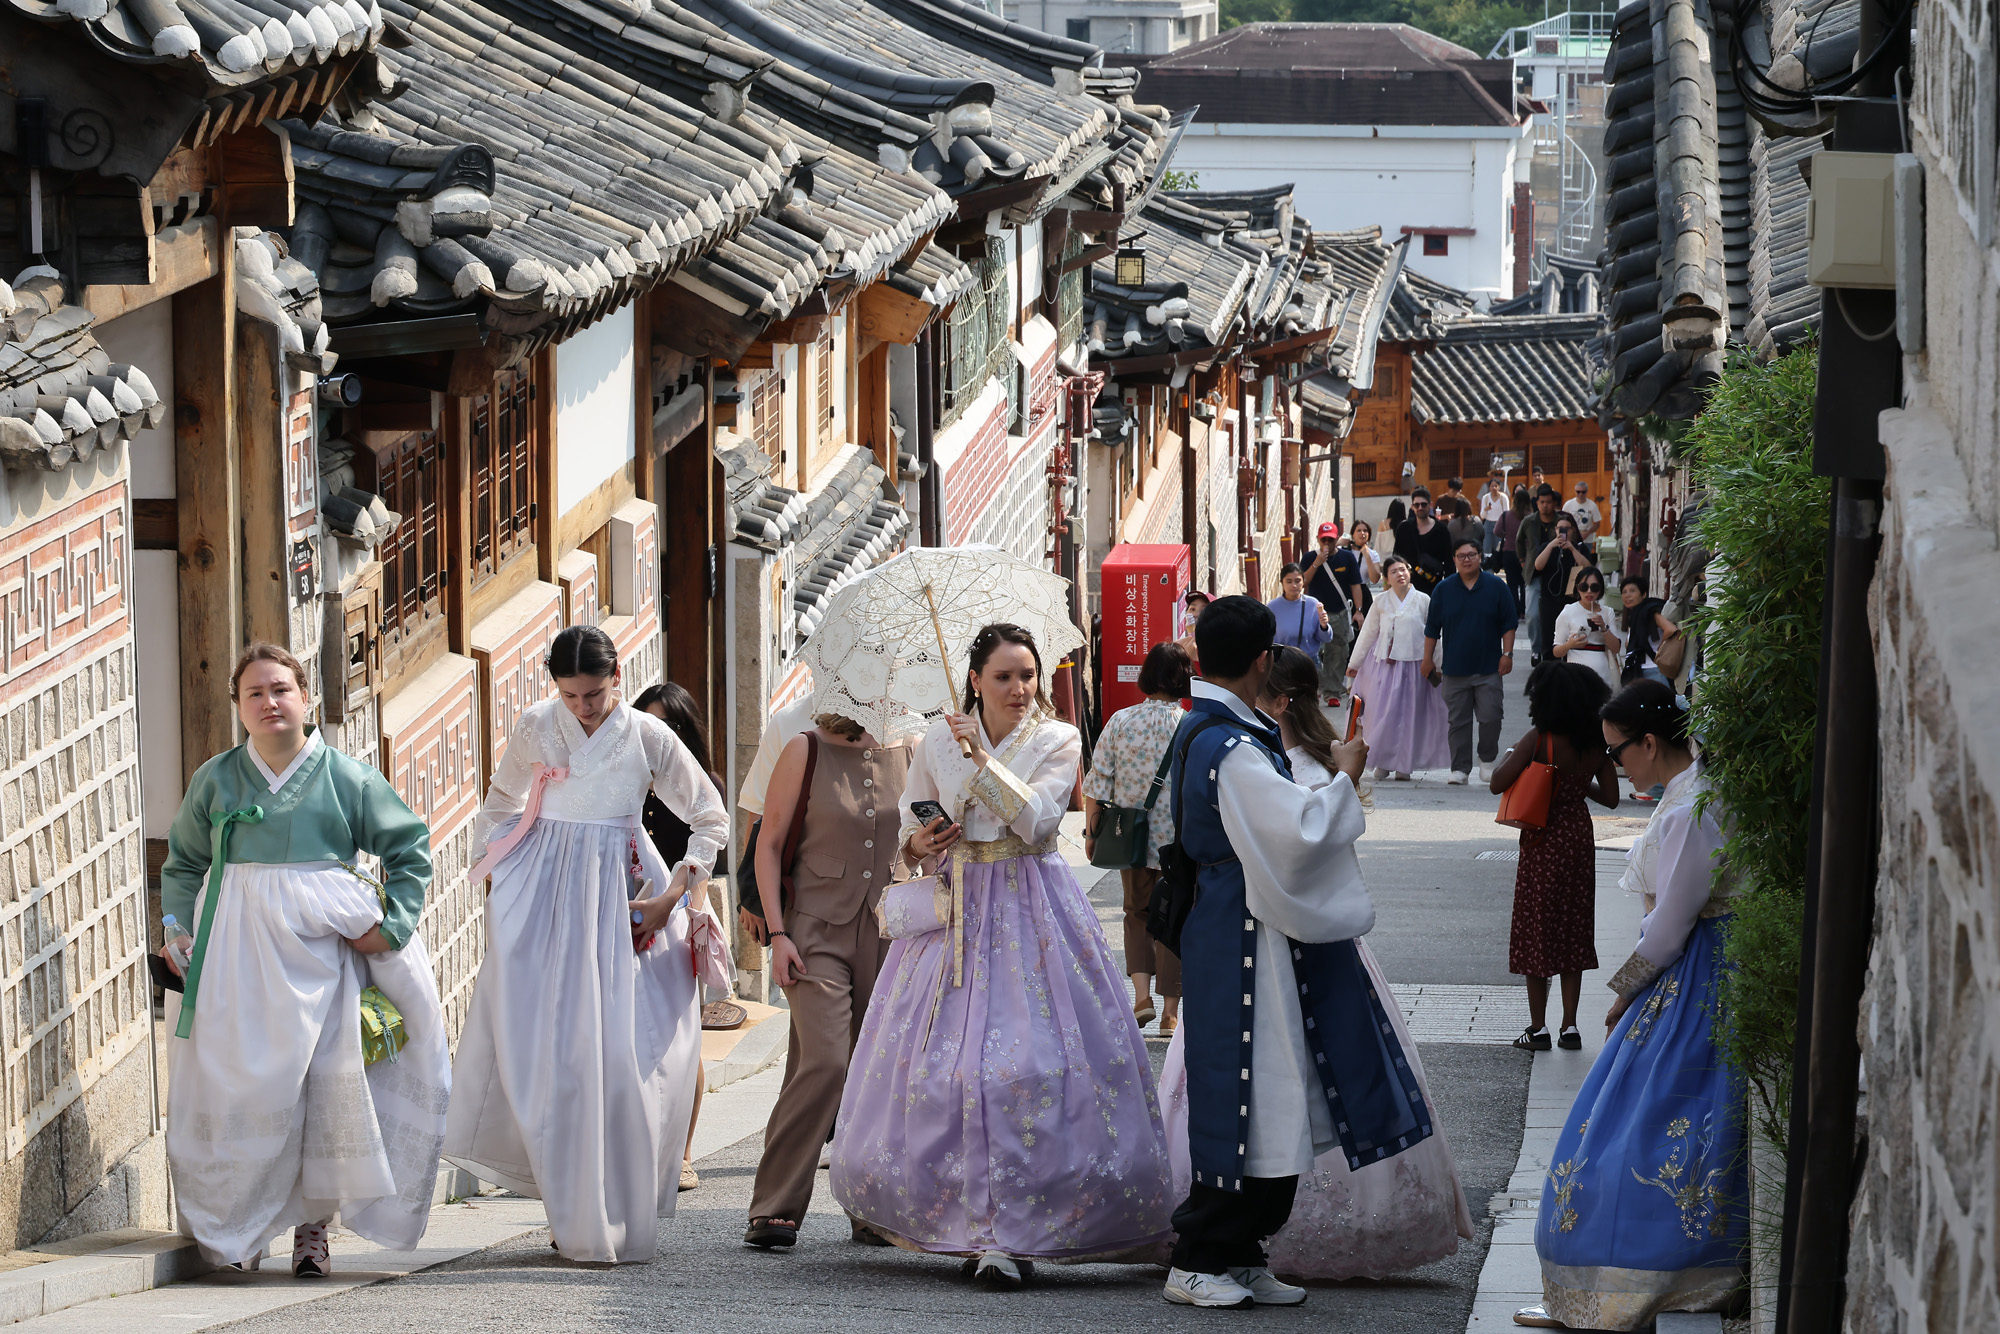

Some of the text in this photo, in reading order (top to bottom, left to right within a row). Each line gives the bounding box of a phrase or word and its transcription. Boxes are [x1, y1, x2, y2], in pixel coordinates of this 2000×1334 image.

[1141, 575, 1149, 612] Emergency
[1125, 574, 1137, 655] 비상소화장치
[1141, 627, 1149, 654] Hydrant
